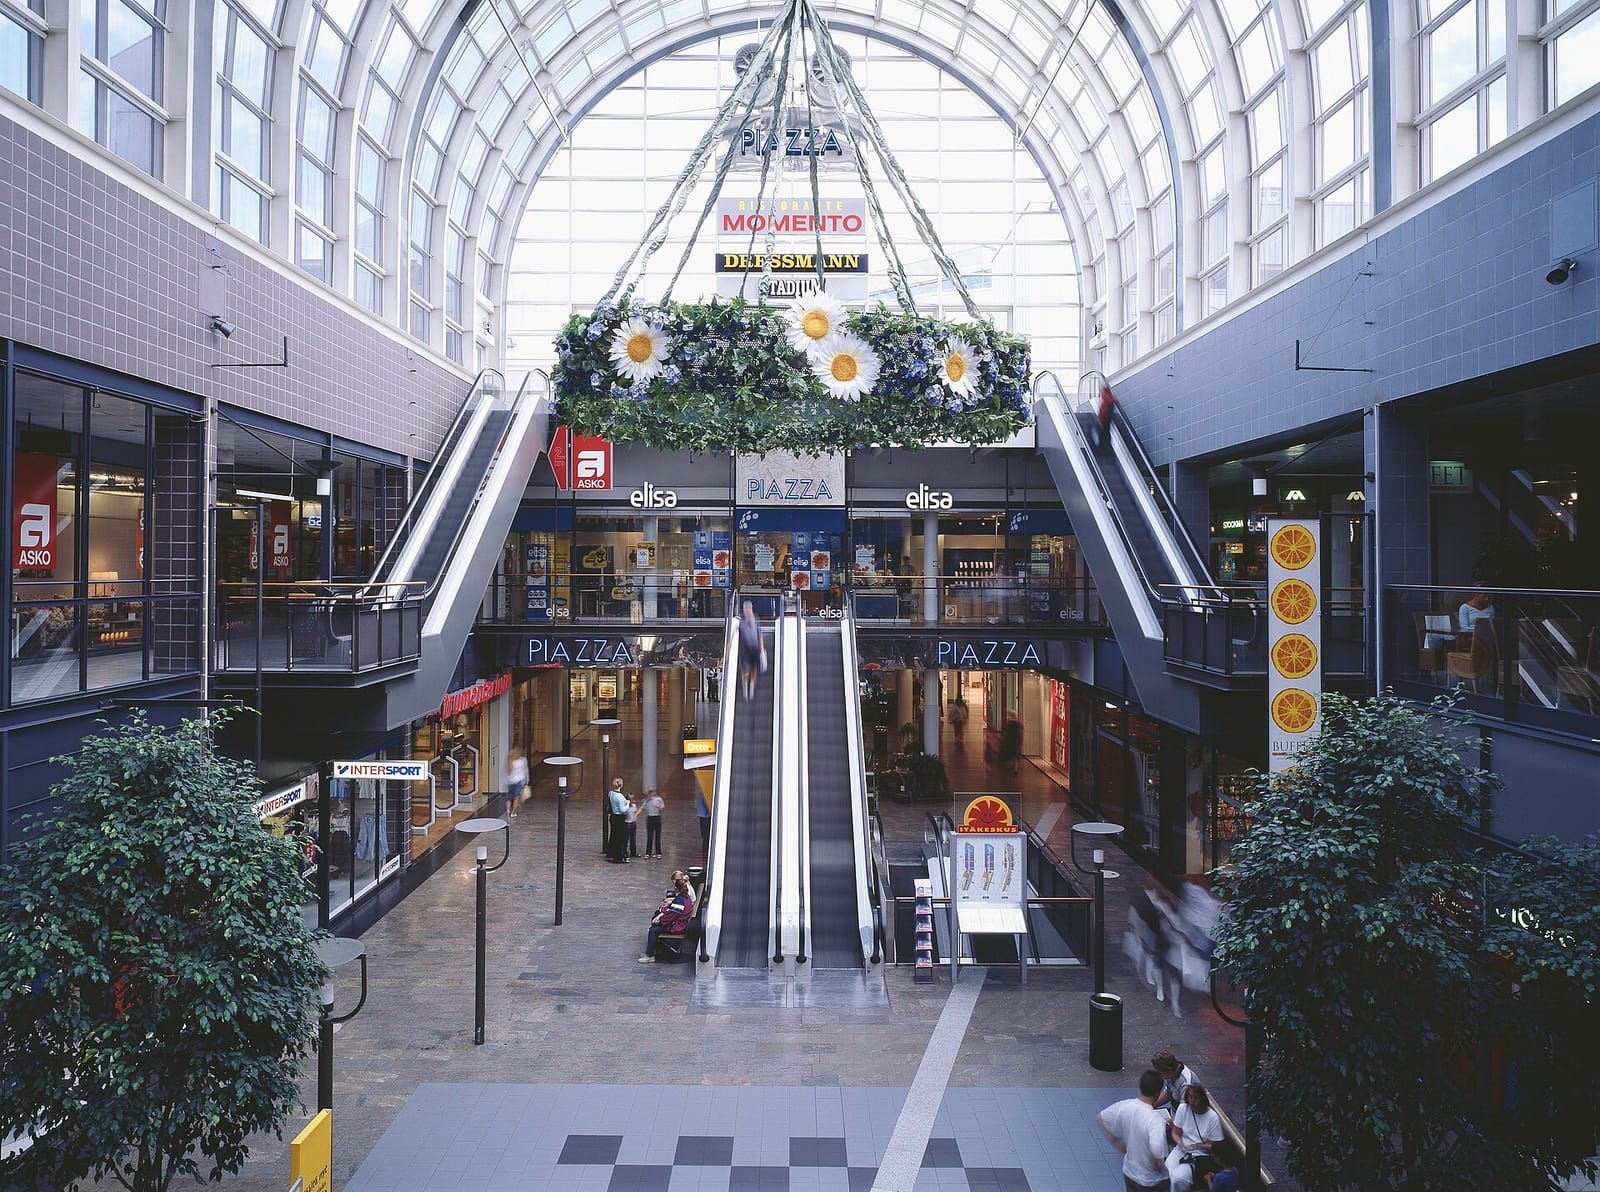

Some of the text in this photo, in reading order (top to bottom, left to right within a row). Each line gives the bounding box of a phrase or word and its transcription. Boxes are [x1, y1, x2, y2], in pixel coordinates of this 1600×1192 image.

[740, 129, 843, 156] PIAZZA
[738, 200, 843, 211] RISORATE
[723, 214, 862, 232] MOMENTO
[768, 276, 826, 298] TADIUM
[577, 479, 606, 488] ASKO
[748, 478, 833, 499] PIAZZA
[630, 481, 678, 508] elisa
[905, 483, 953, 509] elisa
[19, 550, 51, 565] ASKO
[695, 556, 711, 565] elisa
[545, 602, 570, 617] elsa
[819, 606, 842, 619] elisa
[1059, 608, 1084, 620] elisa
[528, 638, 633, 662] PIAZZA
[937, 641, 1041, 665] PIAZZA
[430, 673, 513, 722] trumentarium
[350, 765, 421, 776] INTERSPORT
[264, 788, 302, 813] INTERSPORT
